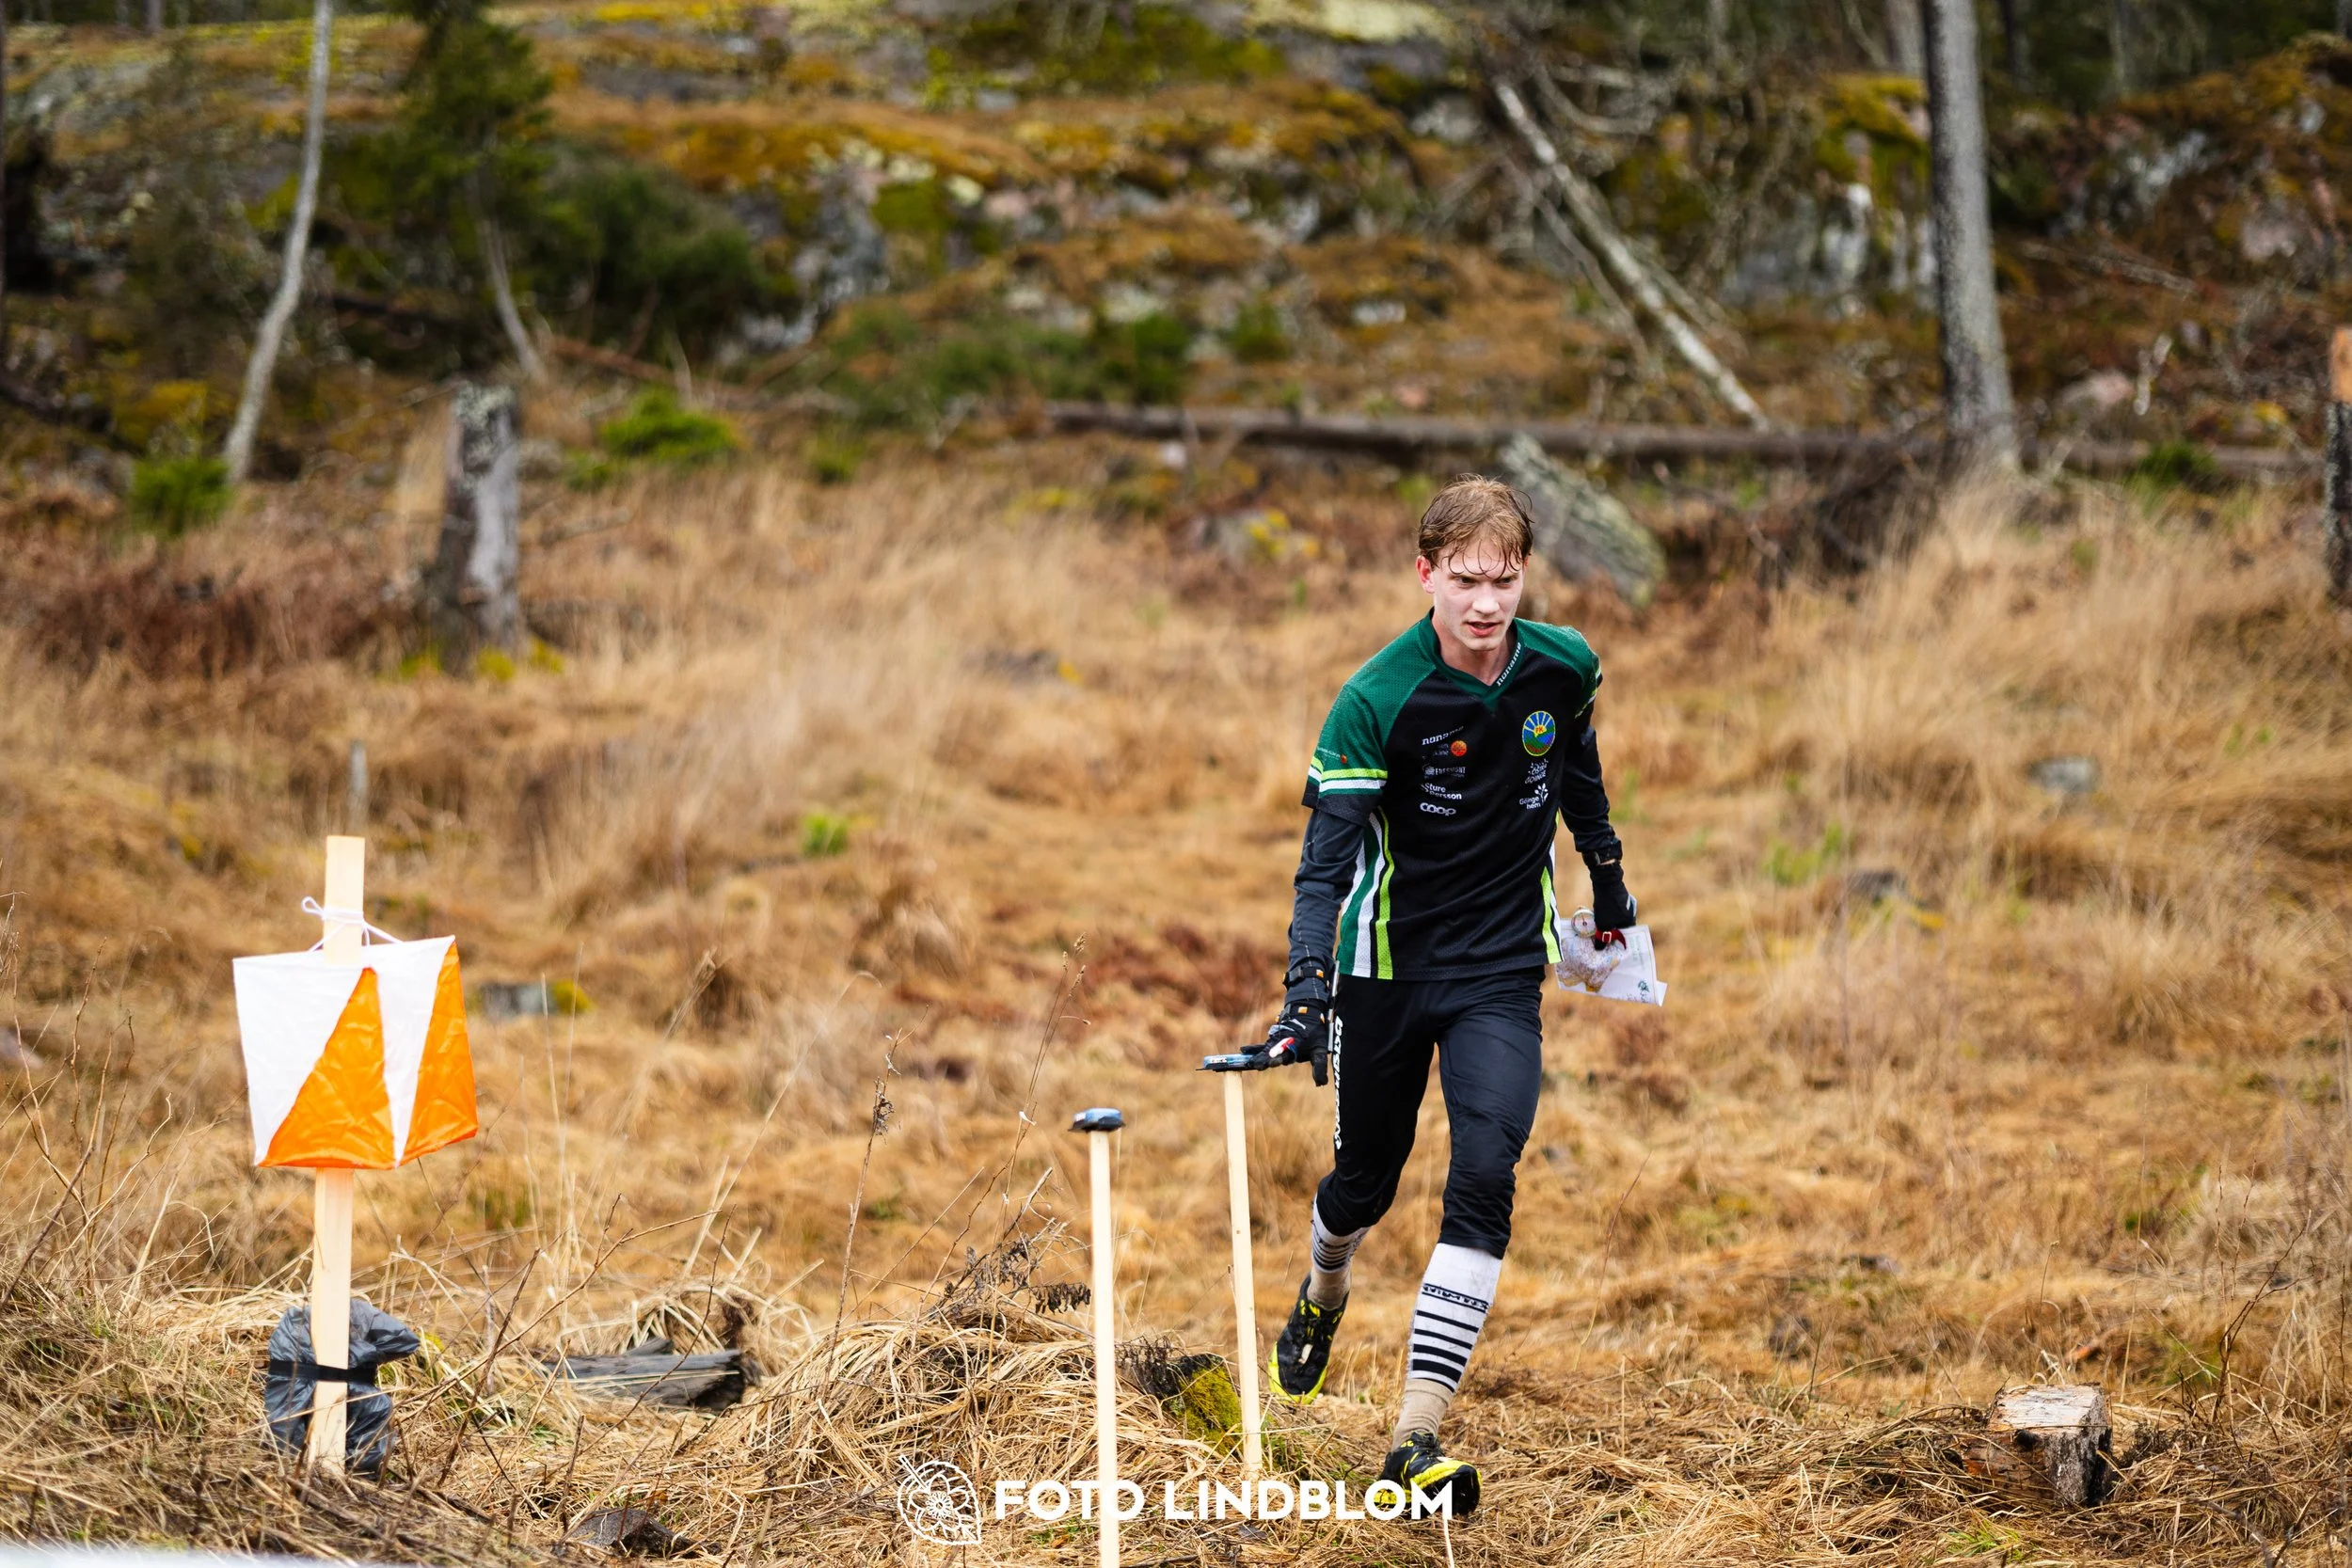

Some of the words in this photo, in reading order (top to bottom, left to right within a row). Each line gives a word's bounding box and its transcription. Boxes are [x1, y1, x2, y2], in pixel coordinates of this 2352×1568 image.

[1495, 641, 1522, 687] noname
[1425, 782, 1447, 793] Sture
[1420, 801, 1456, 816] coop
